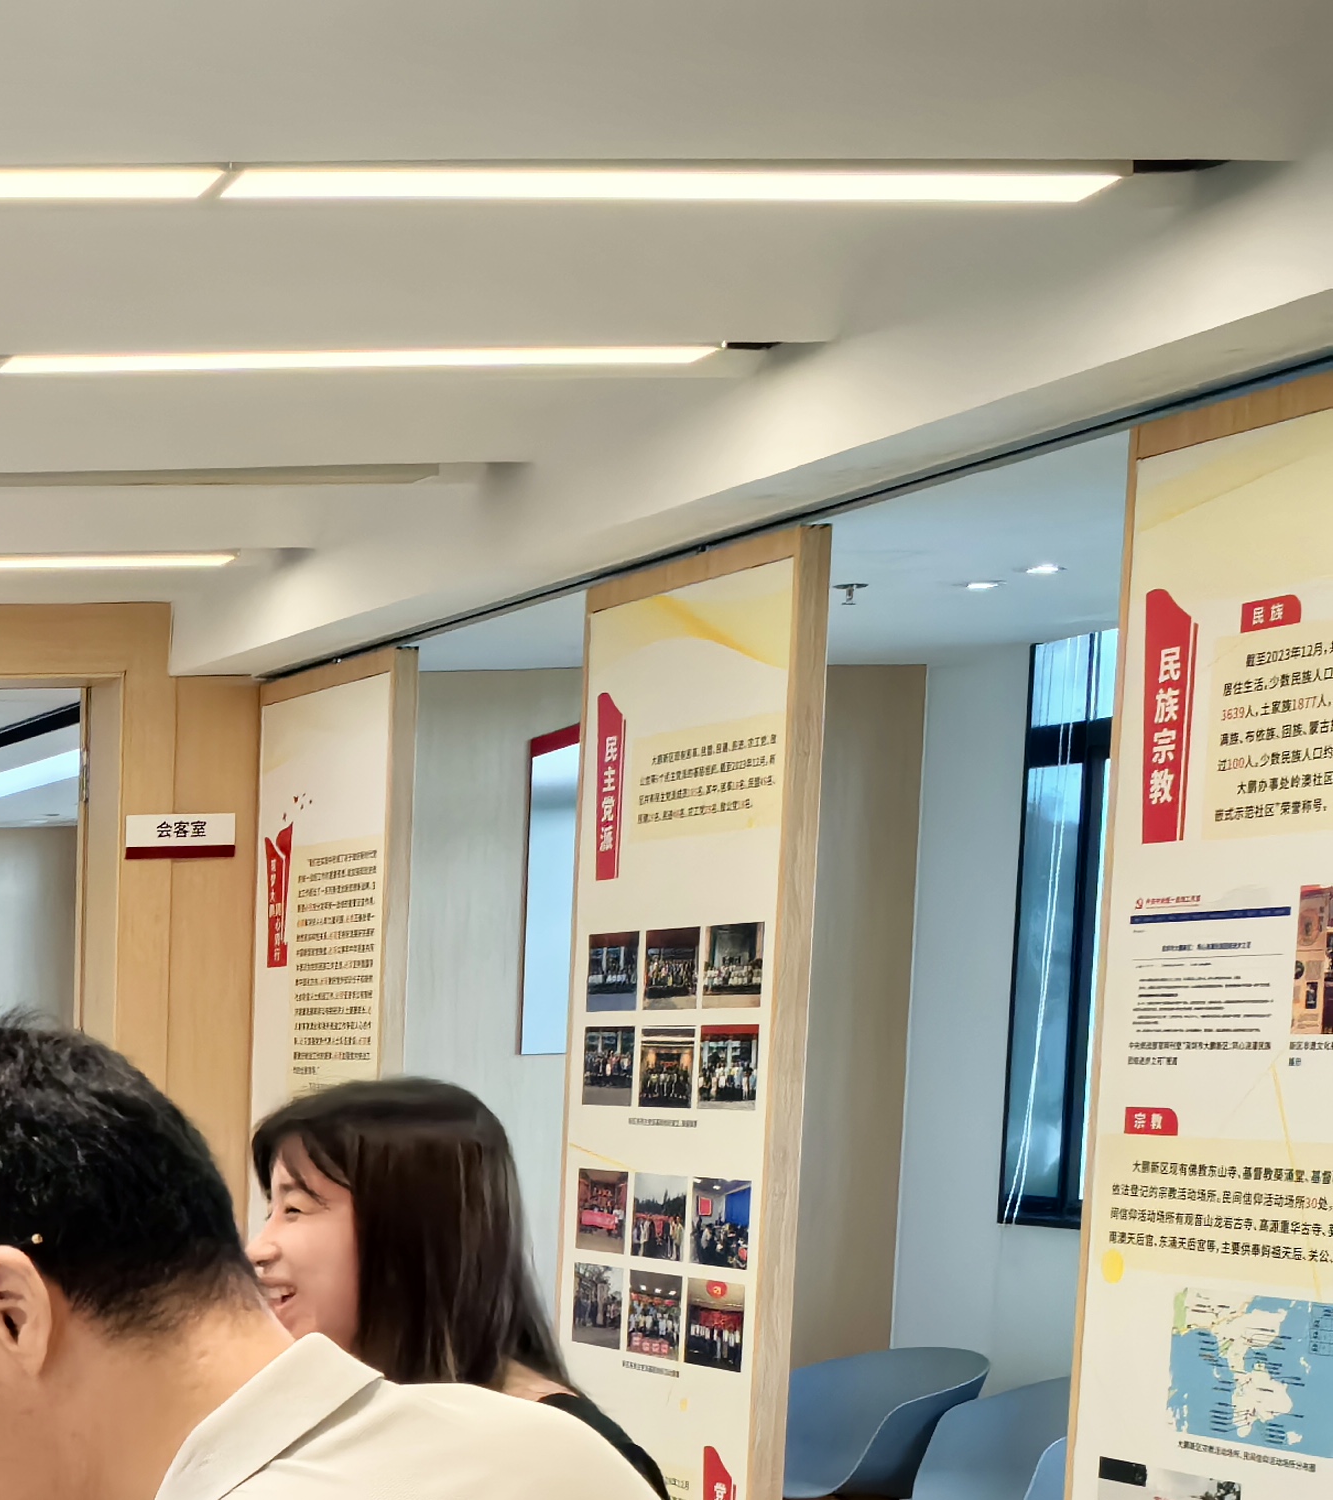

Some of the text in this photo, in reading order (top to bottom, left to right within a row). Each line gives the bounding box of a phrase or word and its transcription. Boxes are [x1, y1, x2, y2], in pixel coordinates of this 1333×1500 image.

[1252, 603, 1285, 625] 民族
[1148, 646, 1182, 805] 民族宗教
[599, 735, 618, 852] 民主党派
[156, 820, 207, 839] 会客室
[1133, 1112, 1164, 1131] 宗教
